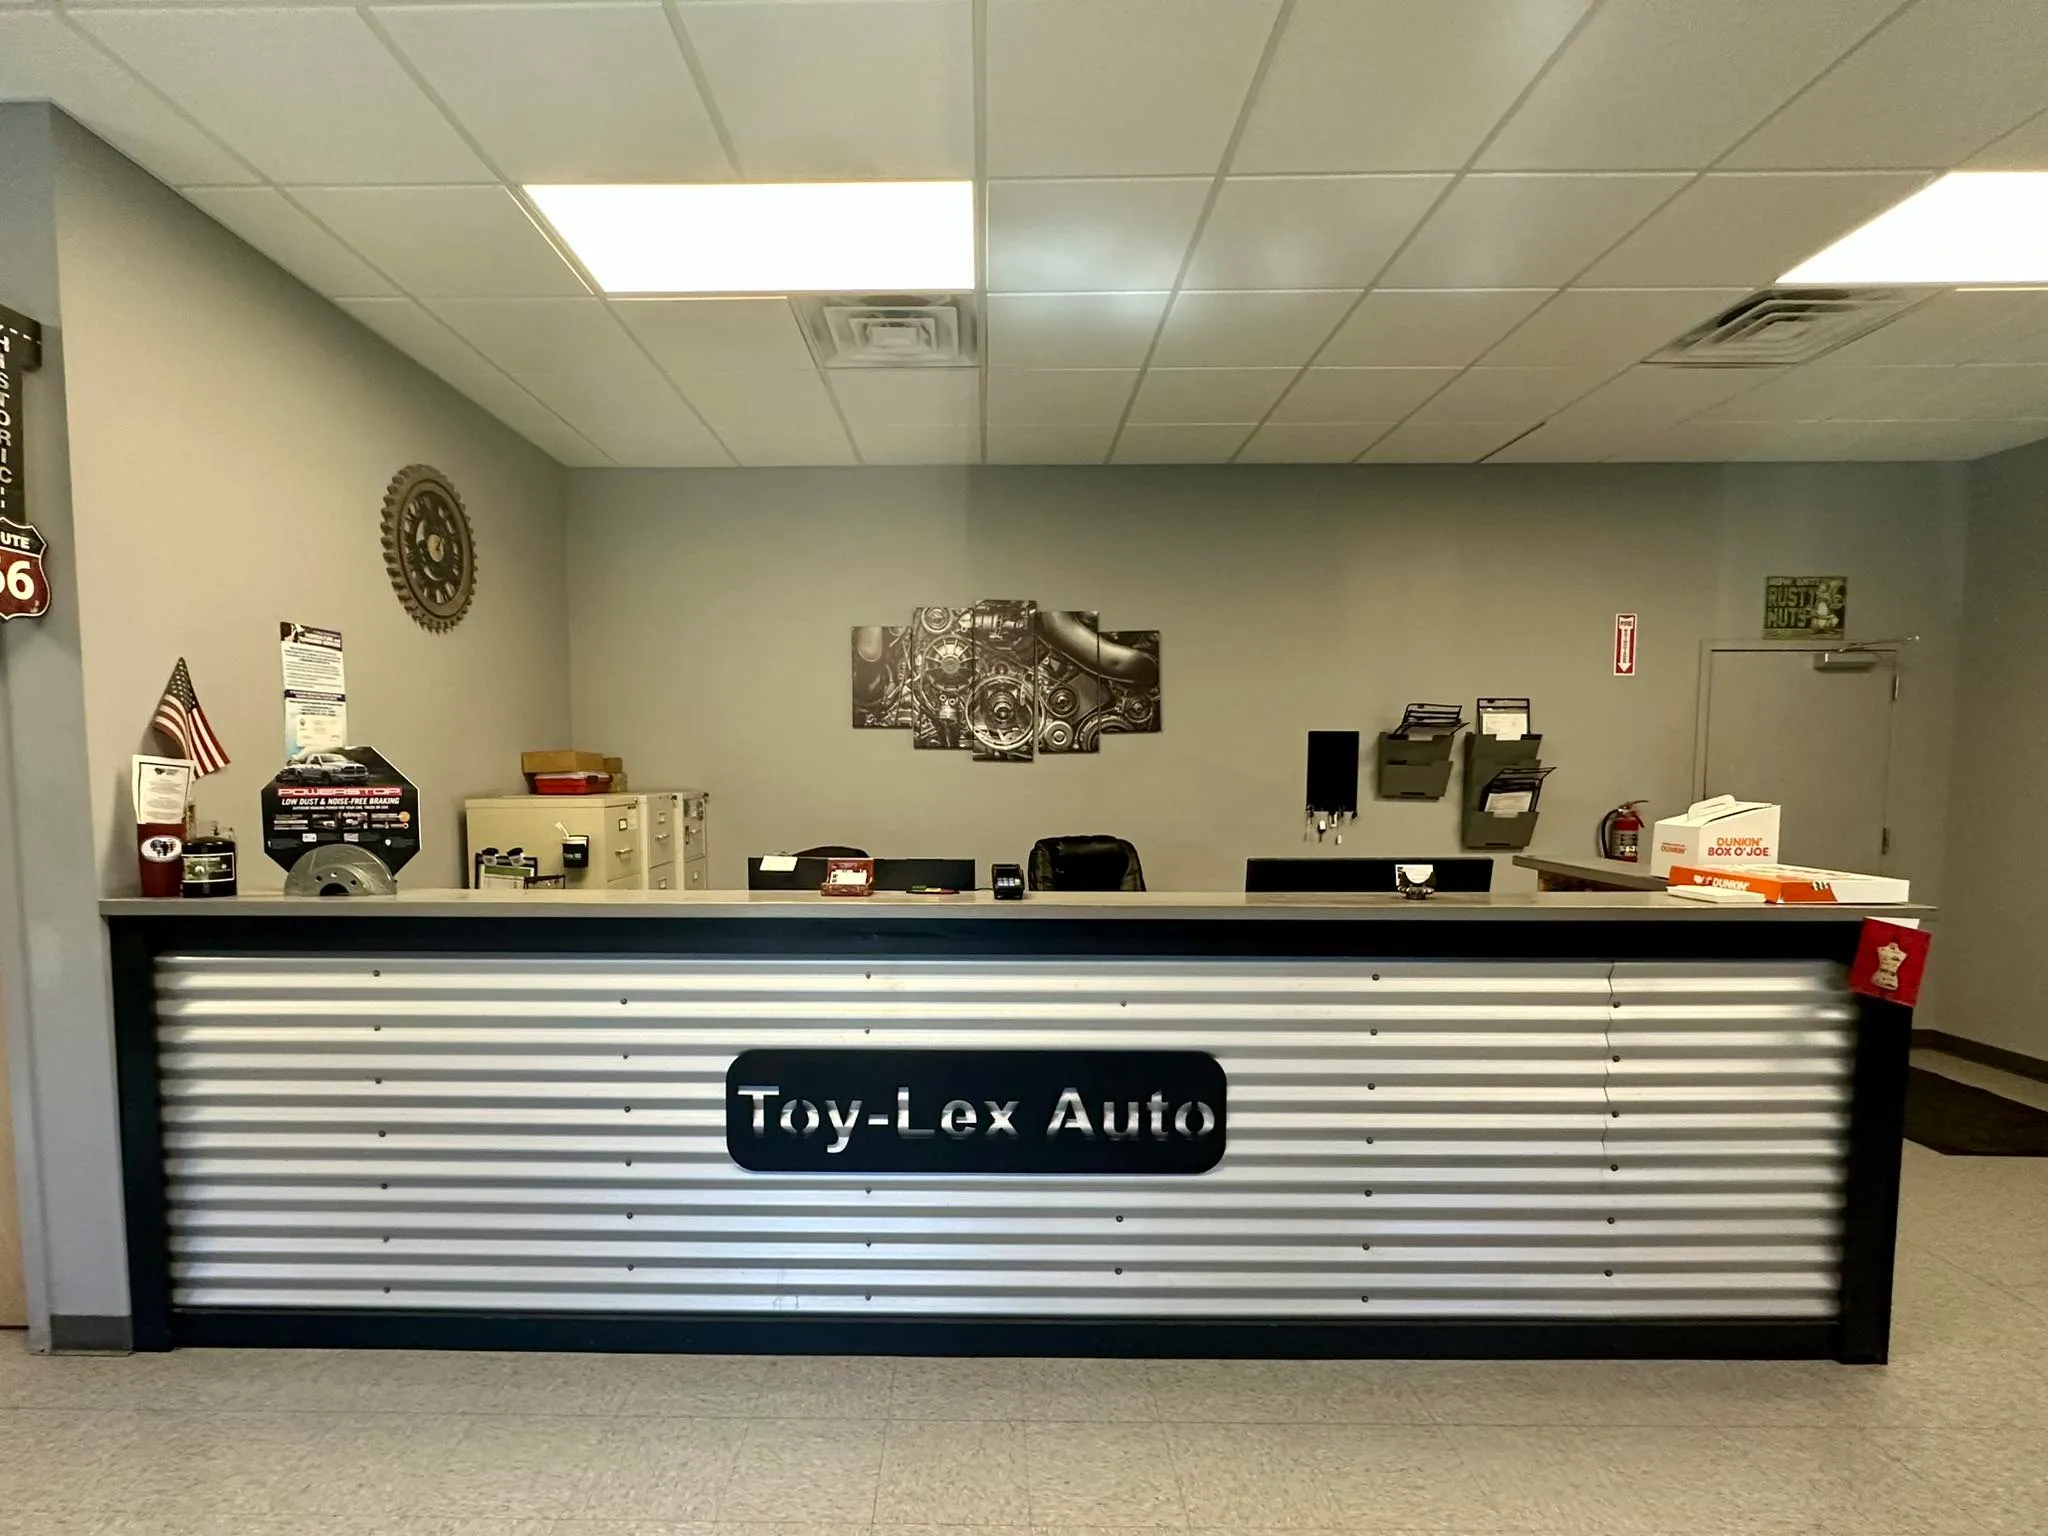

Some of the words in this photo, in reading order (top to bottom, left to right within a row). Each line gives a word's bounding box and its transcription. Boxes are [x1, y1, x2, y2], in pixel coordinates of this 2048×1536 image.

[0, 557, 35, 601] 6
[1767, 607, 1807, 628] NUTS
[327, 797, 367, 805] NOISE-FREE
[1716, 837, 1763, 847] DUNKIN'
[1707, 847, 1732, 856] BOX
[737, 1085, 1020, 1153] Toy-Lex
[1046, 1086, 1216, 1141] Auto
